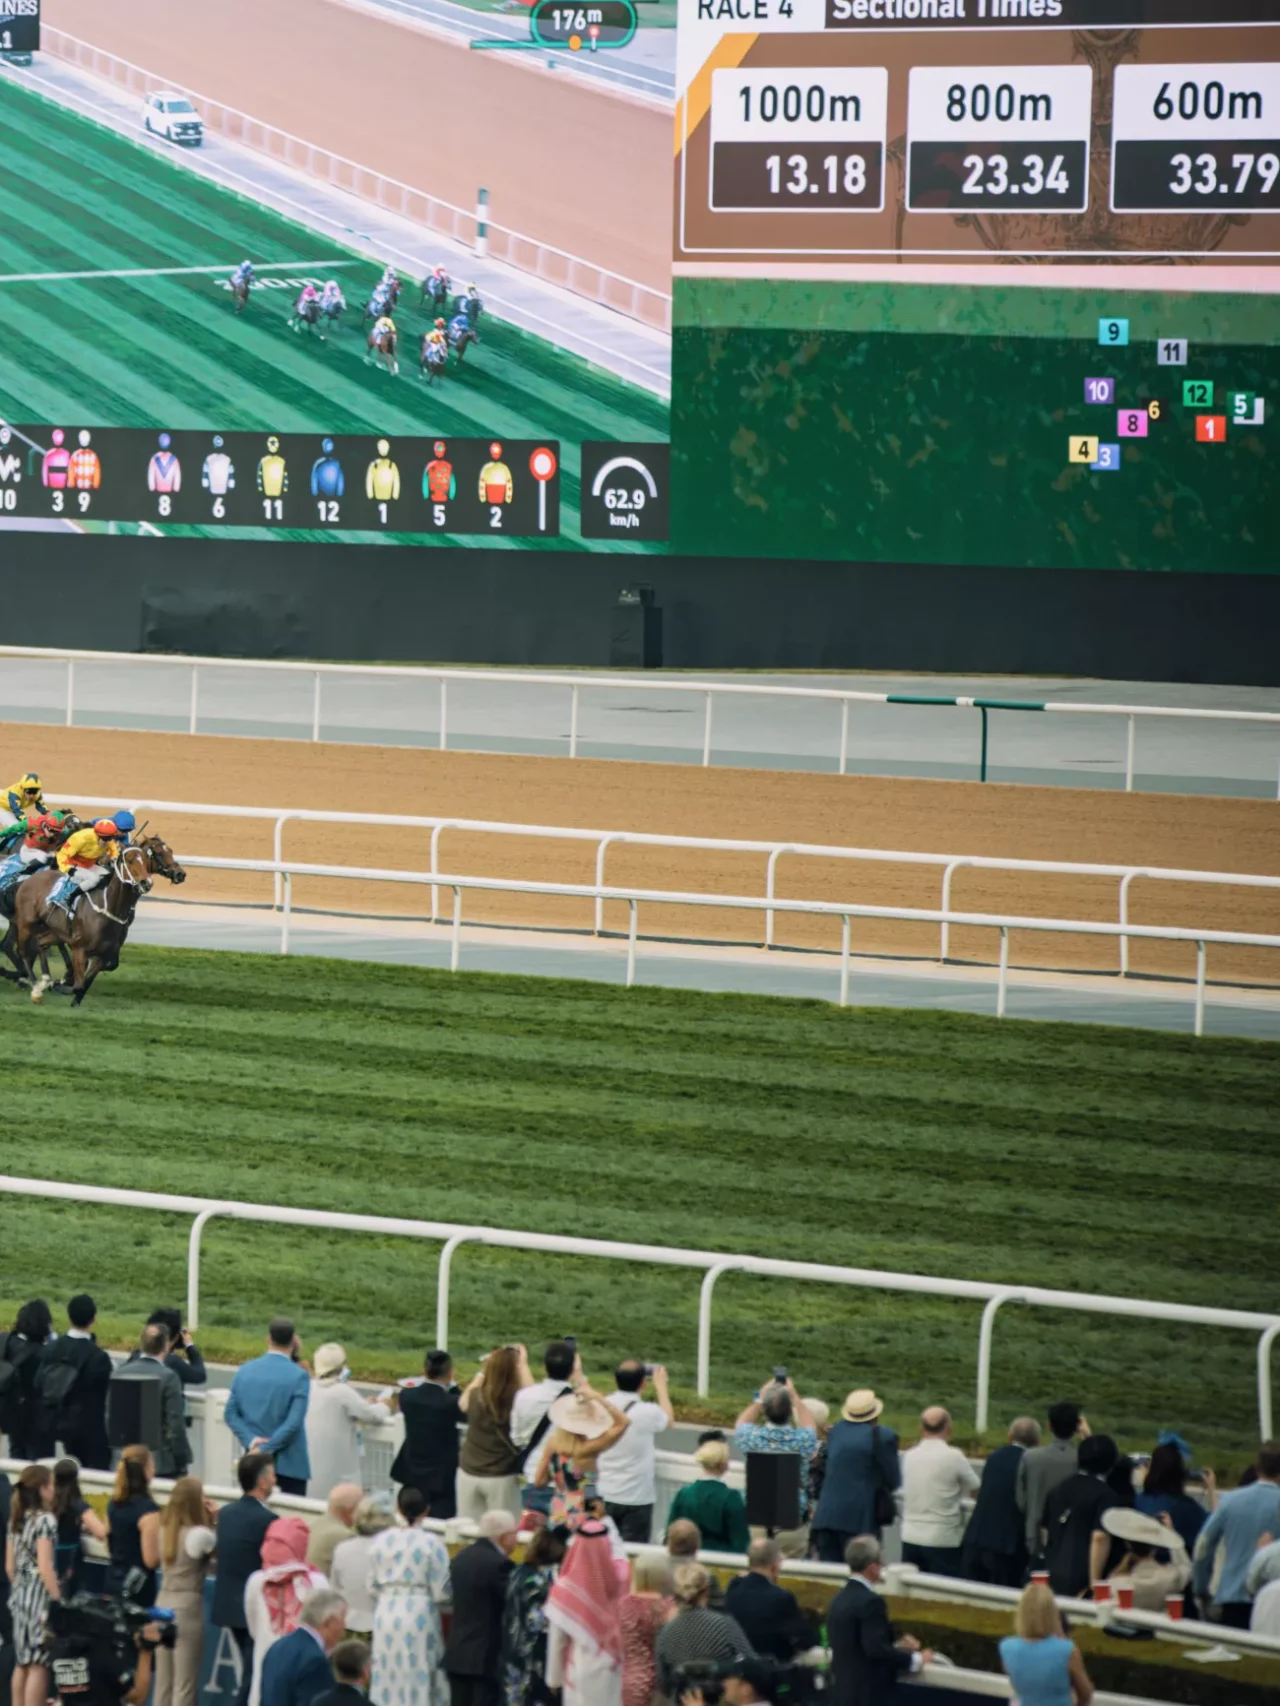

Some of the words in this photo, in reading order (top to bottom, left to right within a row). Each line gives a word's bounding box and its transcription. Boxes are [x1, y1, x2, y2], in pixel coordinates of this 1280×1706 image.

[698, 0, 769, 20] RACE
[778, 0, 794, 19] 4
[832, 0, 966, 20] Sectional
[977, 0, 1063, 18] Times
[739, 85, 861, 122] 1000m
[946, 84, 1052, 121] 800m
[1153, 81, 1262, 120] 600m
[766, 155, 866, 195] 13.18
[962, 154, 1069, 195] 23.34
[1169, 153, 1280, 194] 33.79
[1108, 323, 1120, 342] 9
[1163, 342, 1180, 361] 11
[1089, 381, 1109, 401] 10
[1187, 385, 1207, 404] 12
[1148, 400, 1160, 420] 6
[1234, 394, 1247, 414] 5
[1127, 414, 1139, 432] 8
[1205, 418, 1215, 439] 1
[1078, 440, 1090, 459] 4
[1100, 447, 1111, 467] 3
[52, 491, 64, 511] 3
[78, 492, 91, 512] 9
[158, 495, 171, 517] 8
[212, 498, 226, 519] 6
[262, 499, 283, 520] 11
[317, 501, 340, 522] 12
[378, 503, 388, 524] 1
[433, 505, 446, 526] 5
[490, 507, 502, 528] 2
[603, 488, 646, 511] 62.9
[609, 511, 640, 528] km/h
